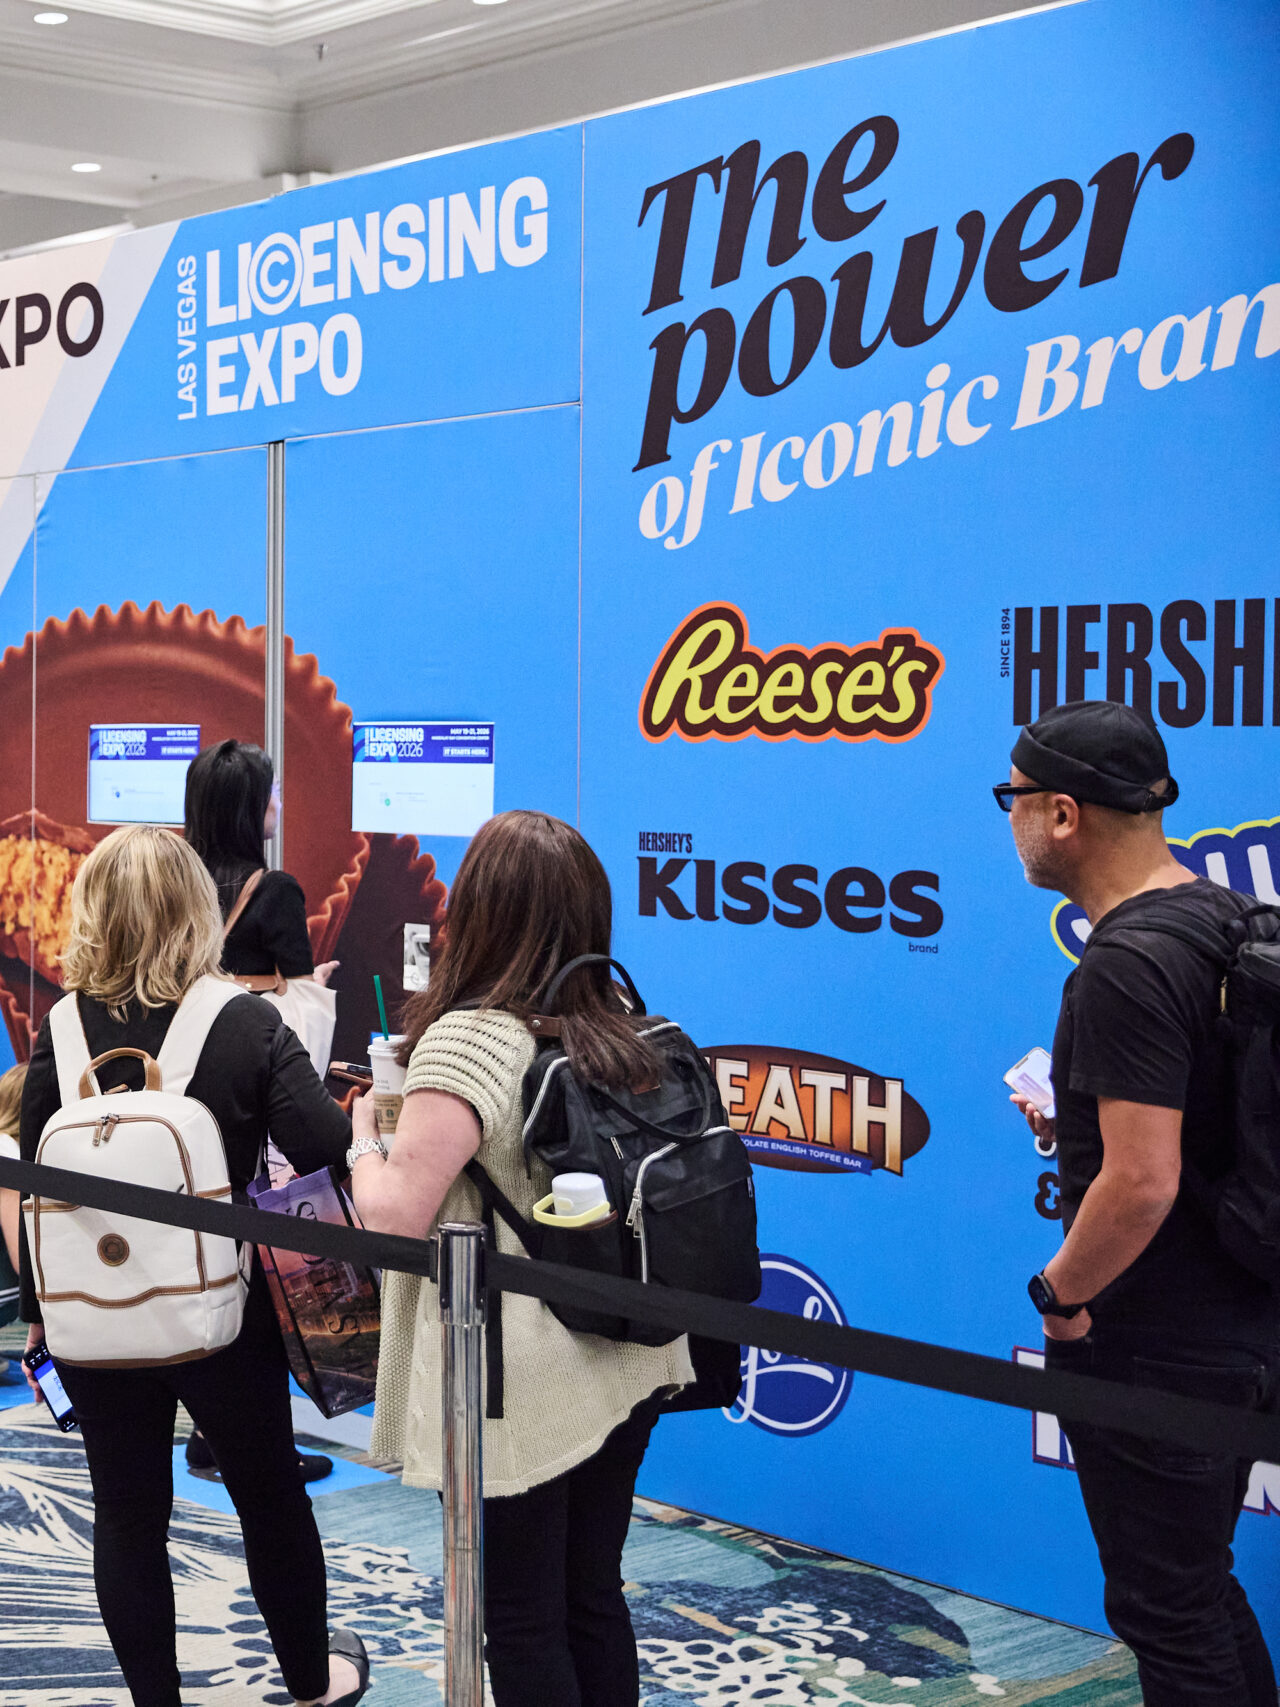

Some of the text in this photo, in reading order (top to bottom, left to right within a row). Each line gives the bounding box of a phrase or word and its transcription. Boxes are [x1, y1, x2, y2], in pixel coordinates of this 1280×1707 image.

[637, 114, 899, 317] The
[178, 255, 197, 420] LAS VEGAS
[632, 132, 1195, 473] power
[206, 313, 363, 416] EXPO
[638, 439, 733, 550] of
[728, 363, 999, 515] Iconic
[651, 619, 926, 726] Reese's
[1001, 608, 1010, 678] SINCE 1894
[1013, 598, 1280, 727] HERSH
[370, 743, 423, 757] EXPO 2026
[638, 831, 693, 853] HERSHEY'S
[908, 942, 938, 954] brand
[706, 1057, 904, 1176] EATH
[771, 1142, 807, 1155] ENGLISH
[809, 1149, 841, 1163] TOFFEE
[843, 1157, 862, 1168] BAR
